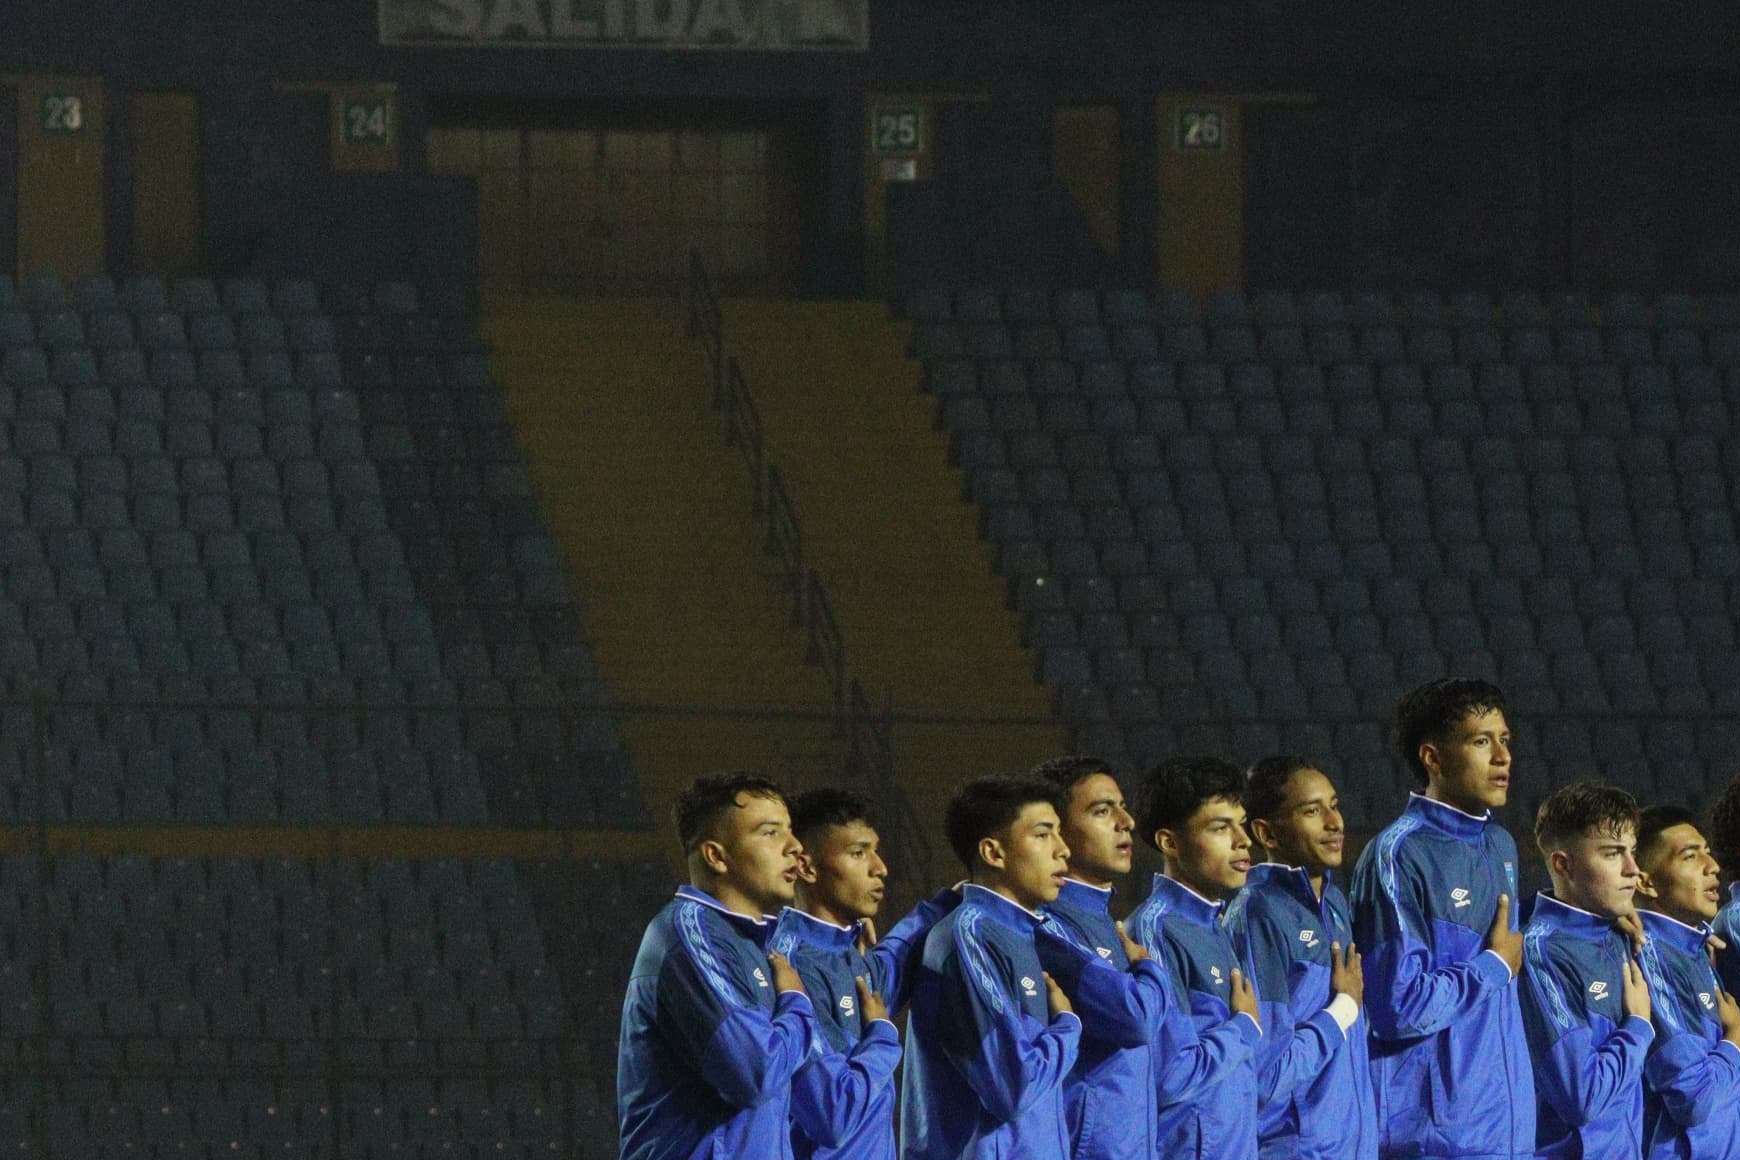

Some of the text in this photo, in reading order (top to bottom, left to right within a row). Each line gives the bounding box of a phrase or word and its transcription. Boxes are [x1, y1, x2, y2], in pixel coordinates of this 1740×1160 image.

[45, 97, 81, 129] 23
[350, 105, 385, 137] 24
[1184, 112, 1219, 145] 26
[880, 113, 914, 146] 25
